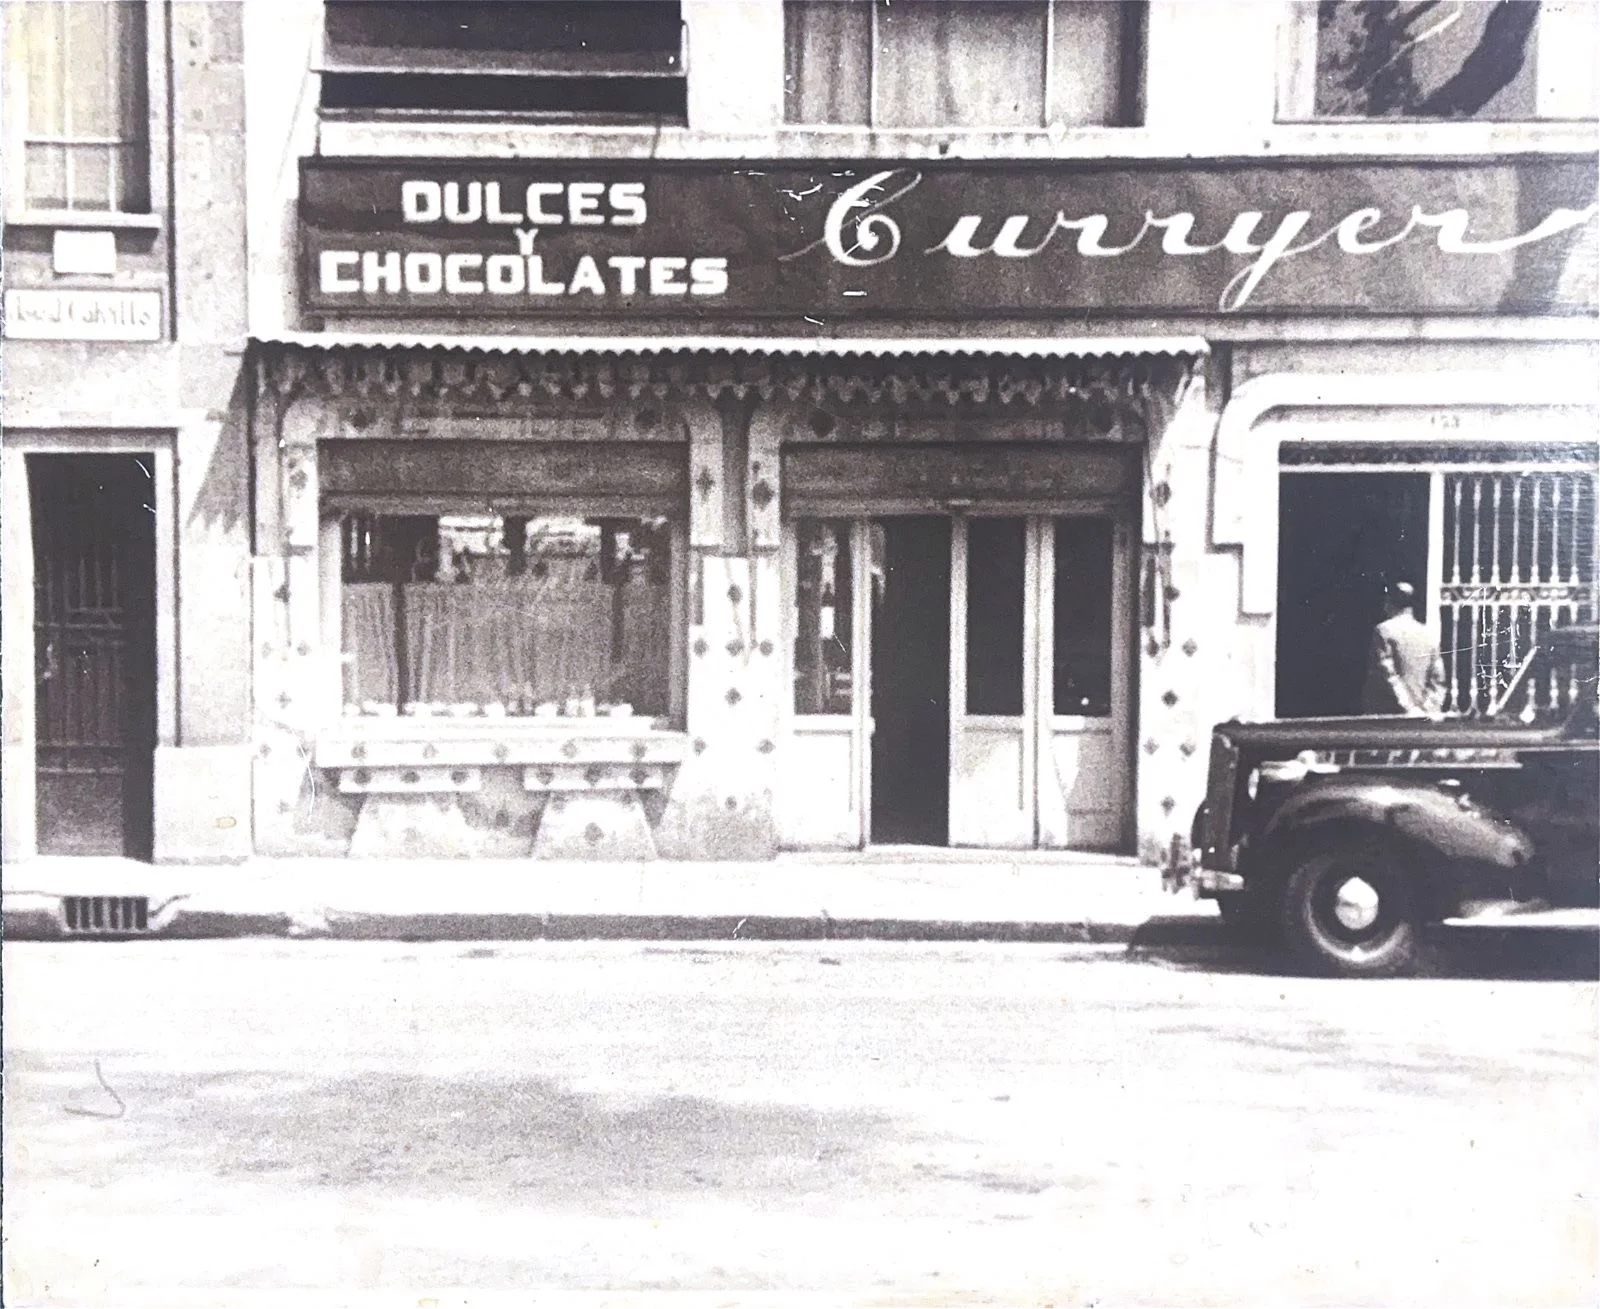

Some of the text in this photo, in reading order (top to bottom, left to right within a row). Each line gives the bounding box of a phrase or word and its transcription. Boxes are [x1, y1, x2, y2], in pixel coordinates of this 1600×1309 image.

[401, 180, 647, 225] DULCES
[513, 227, 539, 256] Y
[318, 246, 728, 295] CHOCOLATES
